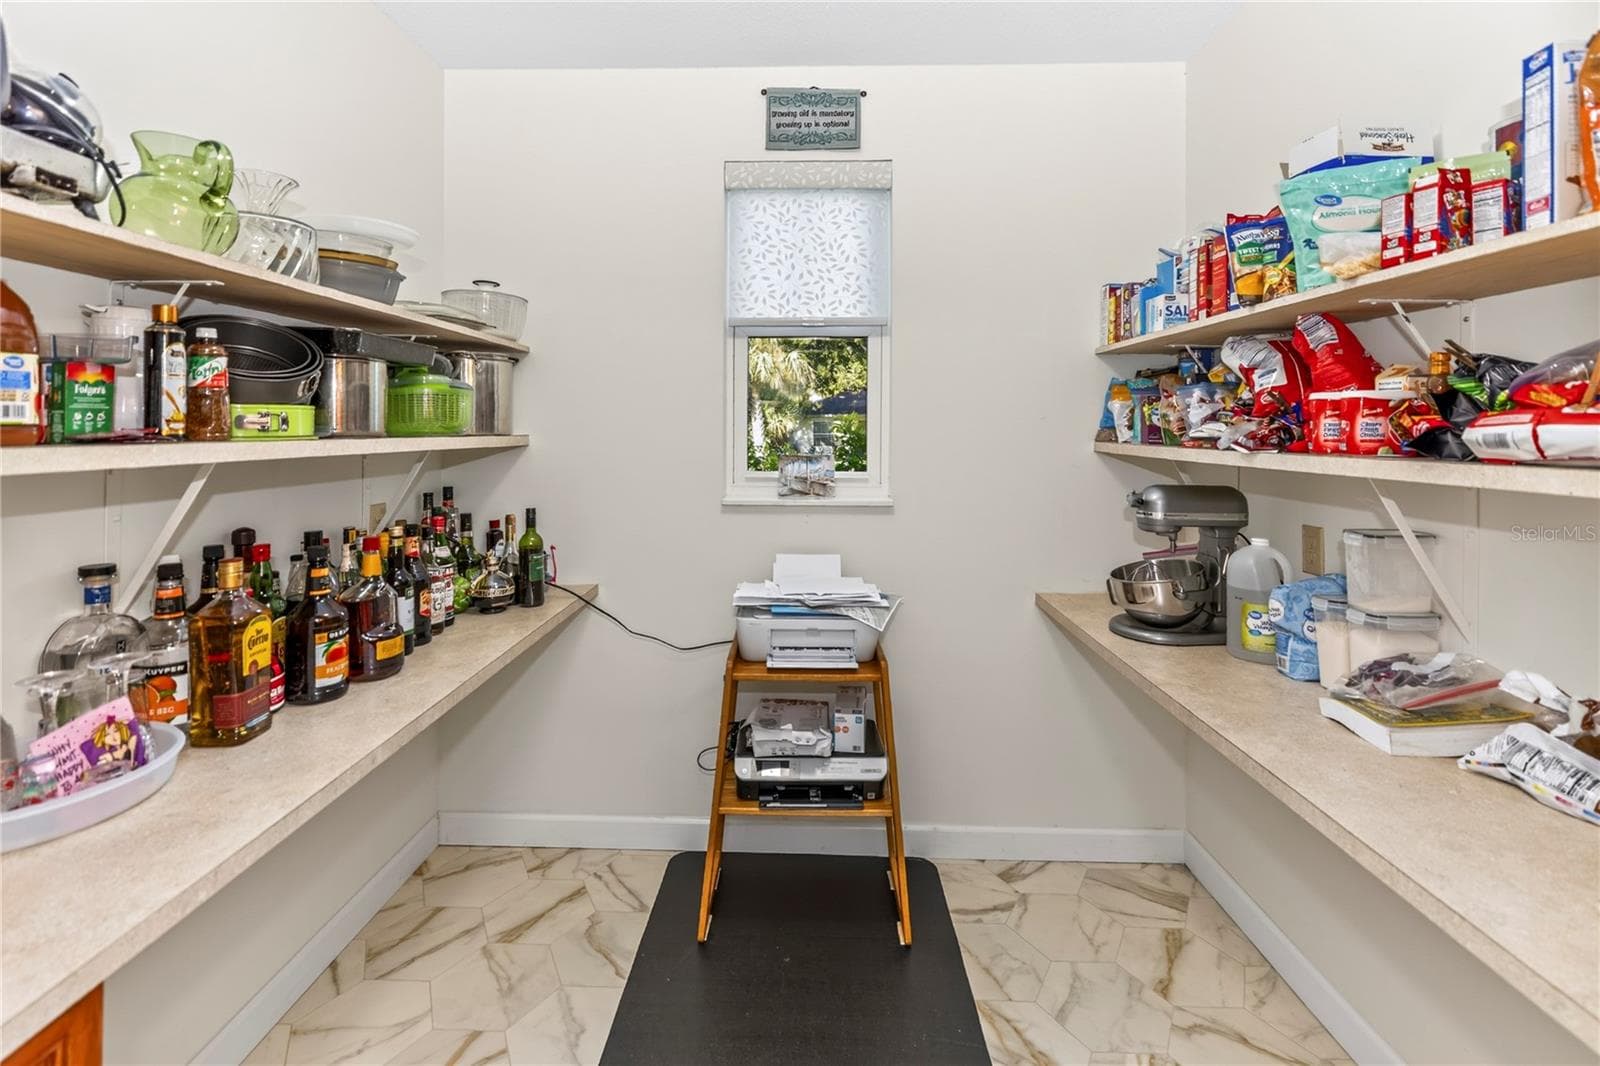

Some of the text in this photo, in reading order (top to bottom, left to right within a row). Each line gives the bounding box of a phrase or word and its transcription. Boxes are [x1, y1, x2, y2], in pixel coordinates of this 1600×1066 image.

[819, 110, 855, 118] mandatory
[775, 121, 802, 129] growing
[803, 121, 813, 129] up
[822, 120, 850, 128] optional
[1318, 209, 1357, 219] Almond
[1164, 304, 1190, 317] SAL
[74, 383, 107, 396] Folgers
